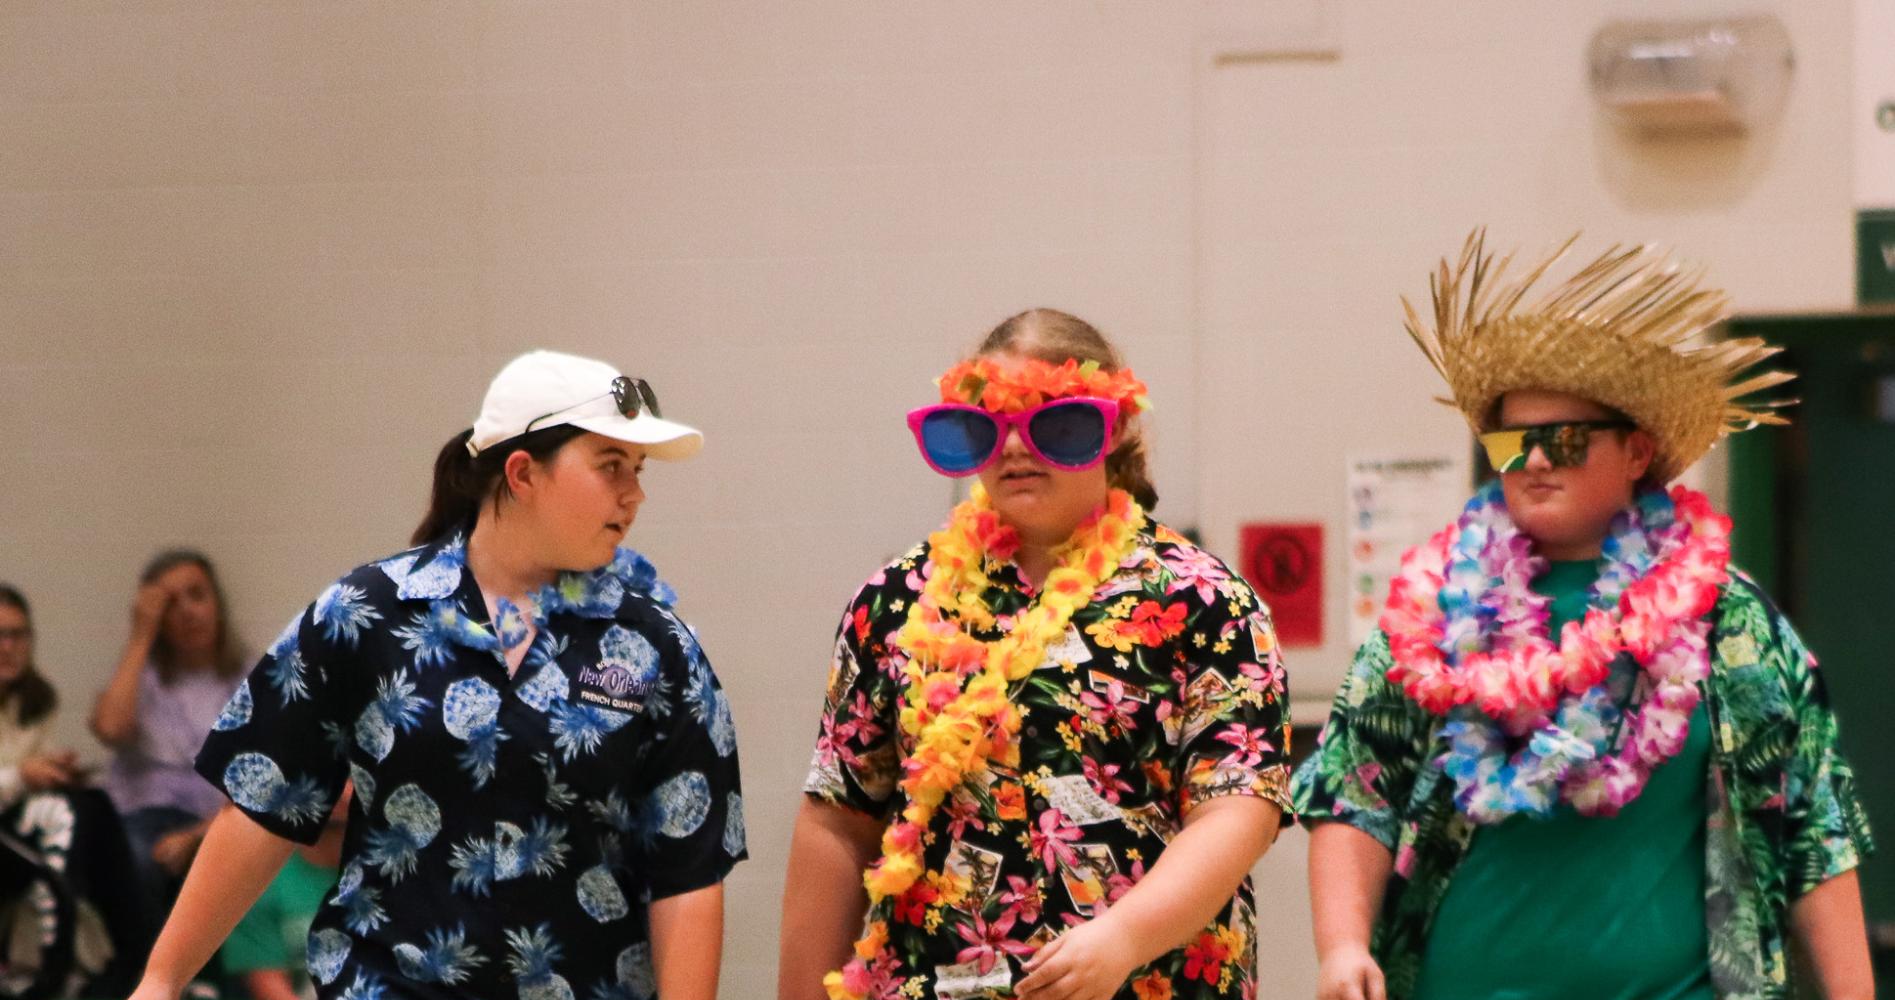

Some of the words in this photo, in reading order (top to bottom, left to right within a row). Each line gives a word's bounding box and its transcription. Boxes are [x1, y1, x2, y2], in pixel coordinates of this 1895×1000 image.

[579, 665, 605, 687] New
[610, 671, 652, 696] Orlean
[581, 691, 610, 706] FRENCH
